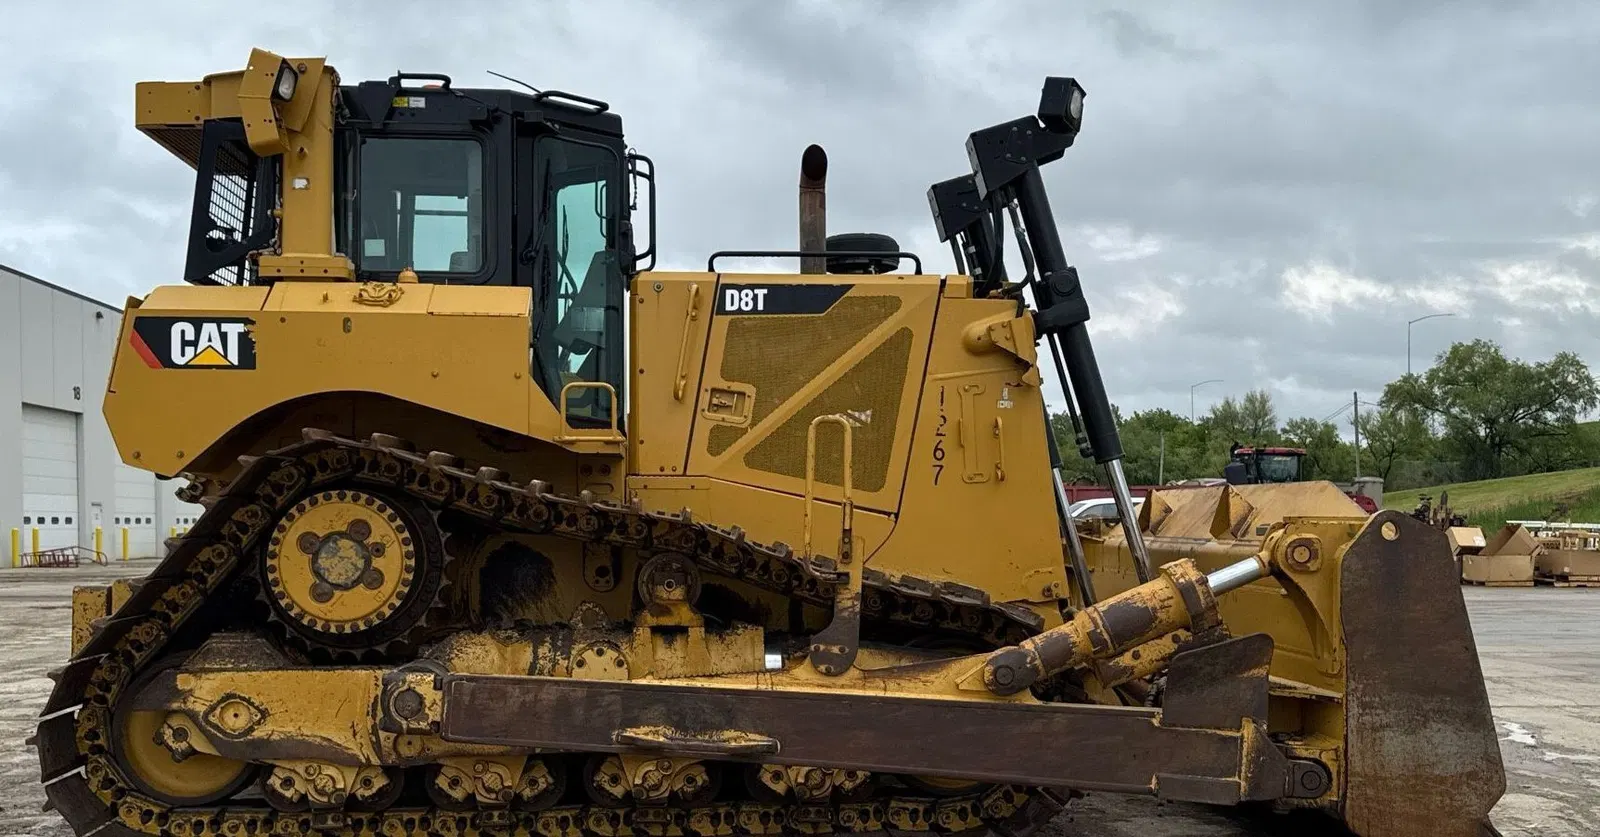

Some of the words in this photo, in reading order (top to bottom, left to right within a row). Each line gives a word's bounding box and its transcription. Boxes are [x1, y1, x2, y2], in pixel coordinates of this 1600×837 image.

[725, 288, 768, 311] D8T
[170, 321, 245, 366] CAT
[72, 385, 81, 401] 18
